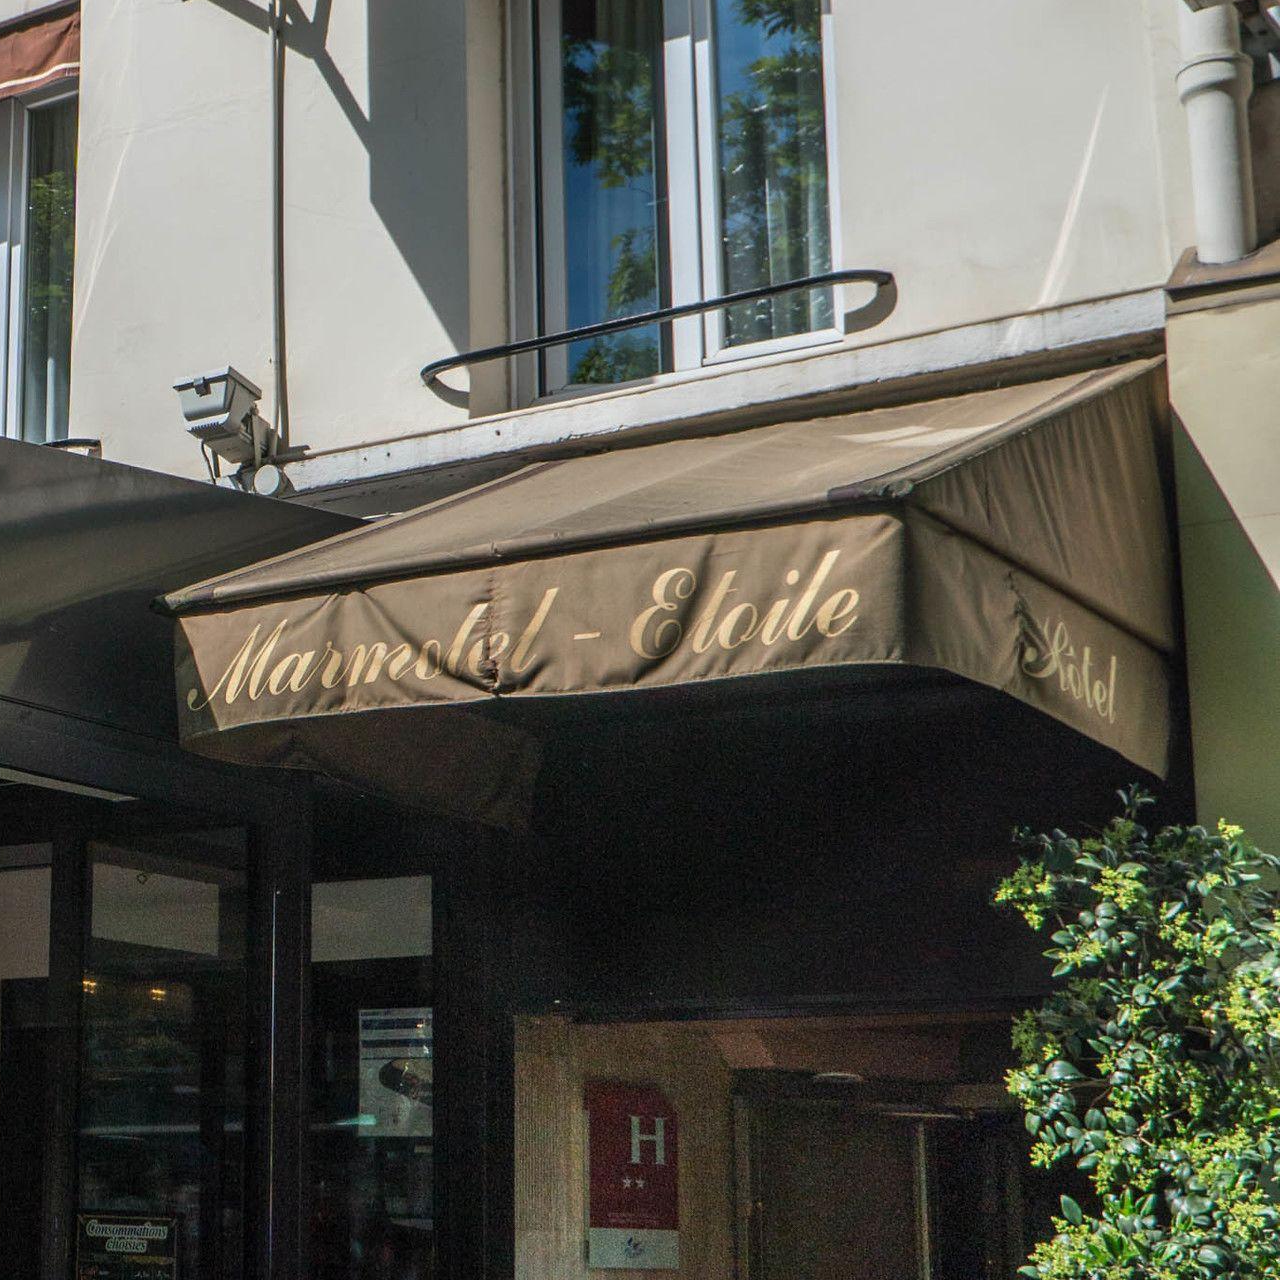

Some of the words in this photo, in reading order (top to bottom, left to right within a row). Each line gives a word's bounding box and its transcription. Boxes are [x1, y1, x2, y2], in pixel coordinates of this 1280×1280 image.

[186, 586, 559, 711] Marmotel
[627, 549, 861, 662] Etoile
[1021, 617, 1118, 725] Hôtel
[629, 1114, 667, 1166] H
